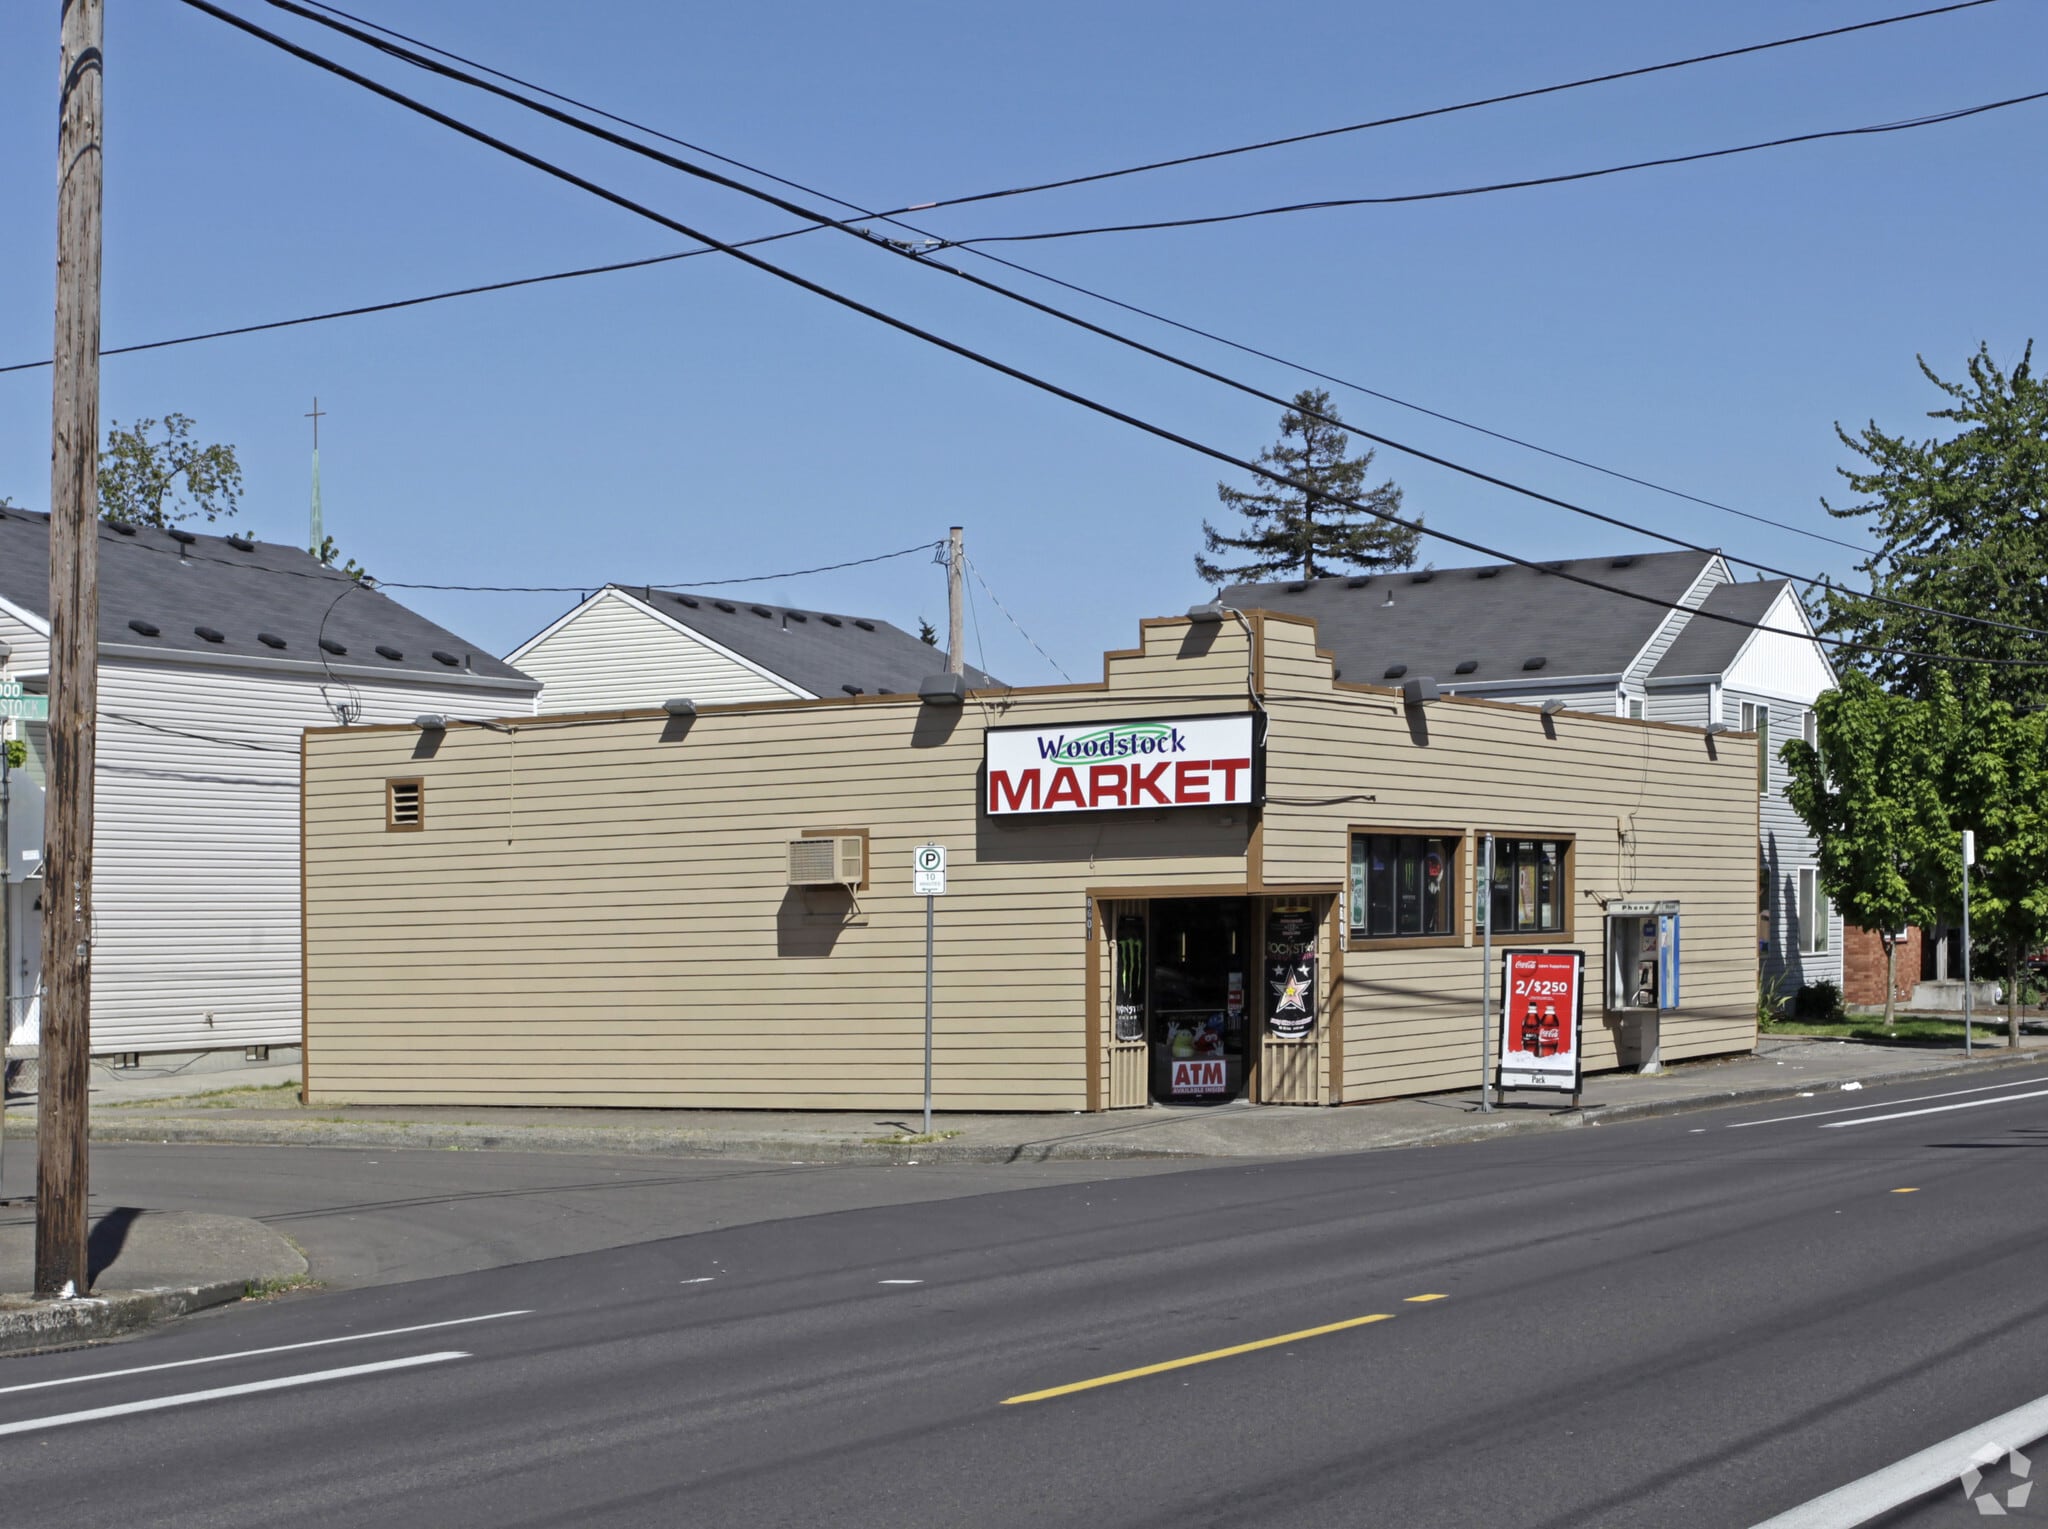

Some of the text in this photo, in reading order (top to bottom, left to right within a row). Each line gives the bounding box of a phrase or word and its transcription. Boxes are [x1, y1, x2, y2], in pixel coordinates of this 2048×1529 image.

[0, 684, 21, 698] 00
[1037, 728, 1186, 760] Woodstock
[989, 758, 1250, 812] MARKET
[1174, 1063, 1224, 1086] ATM
